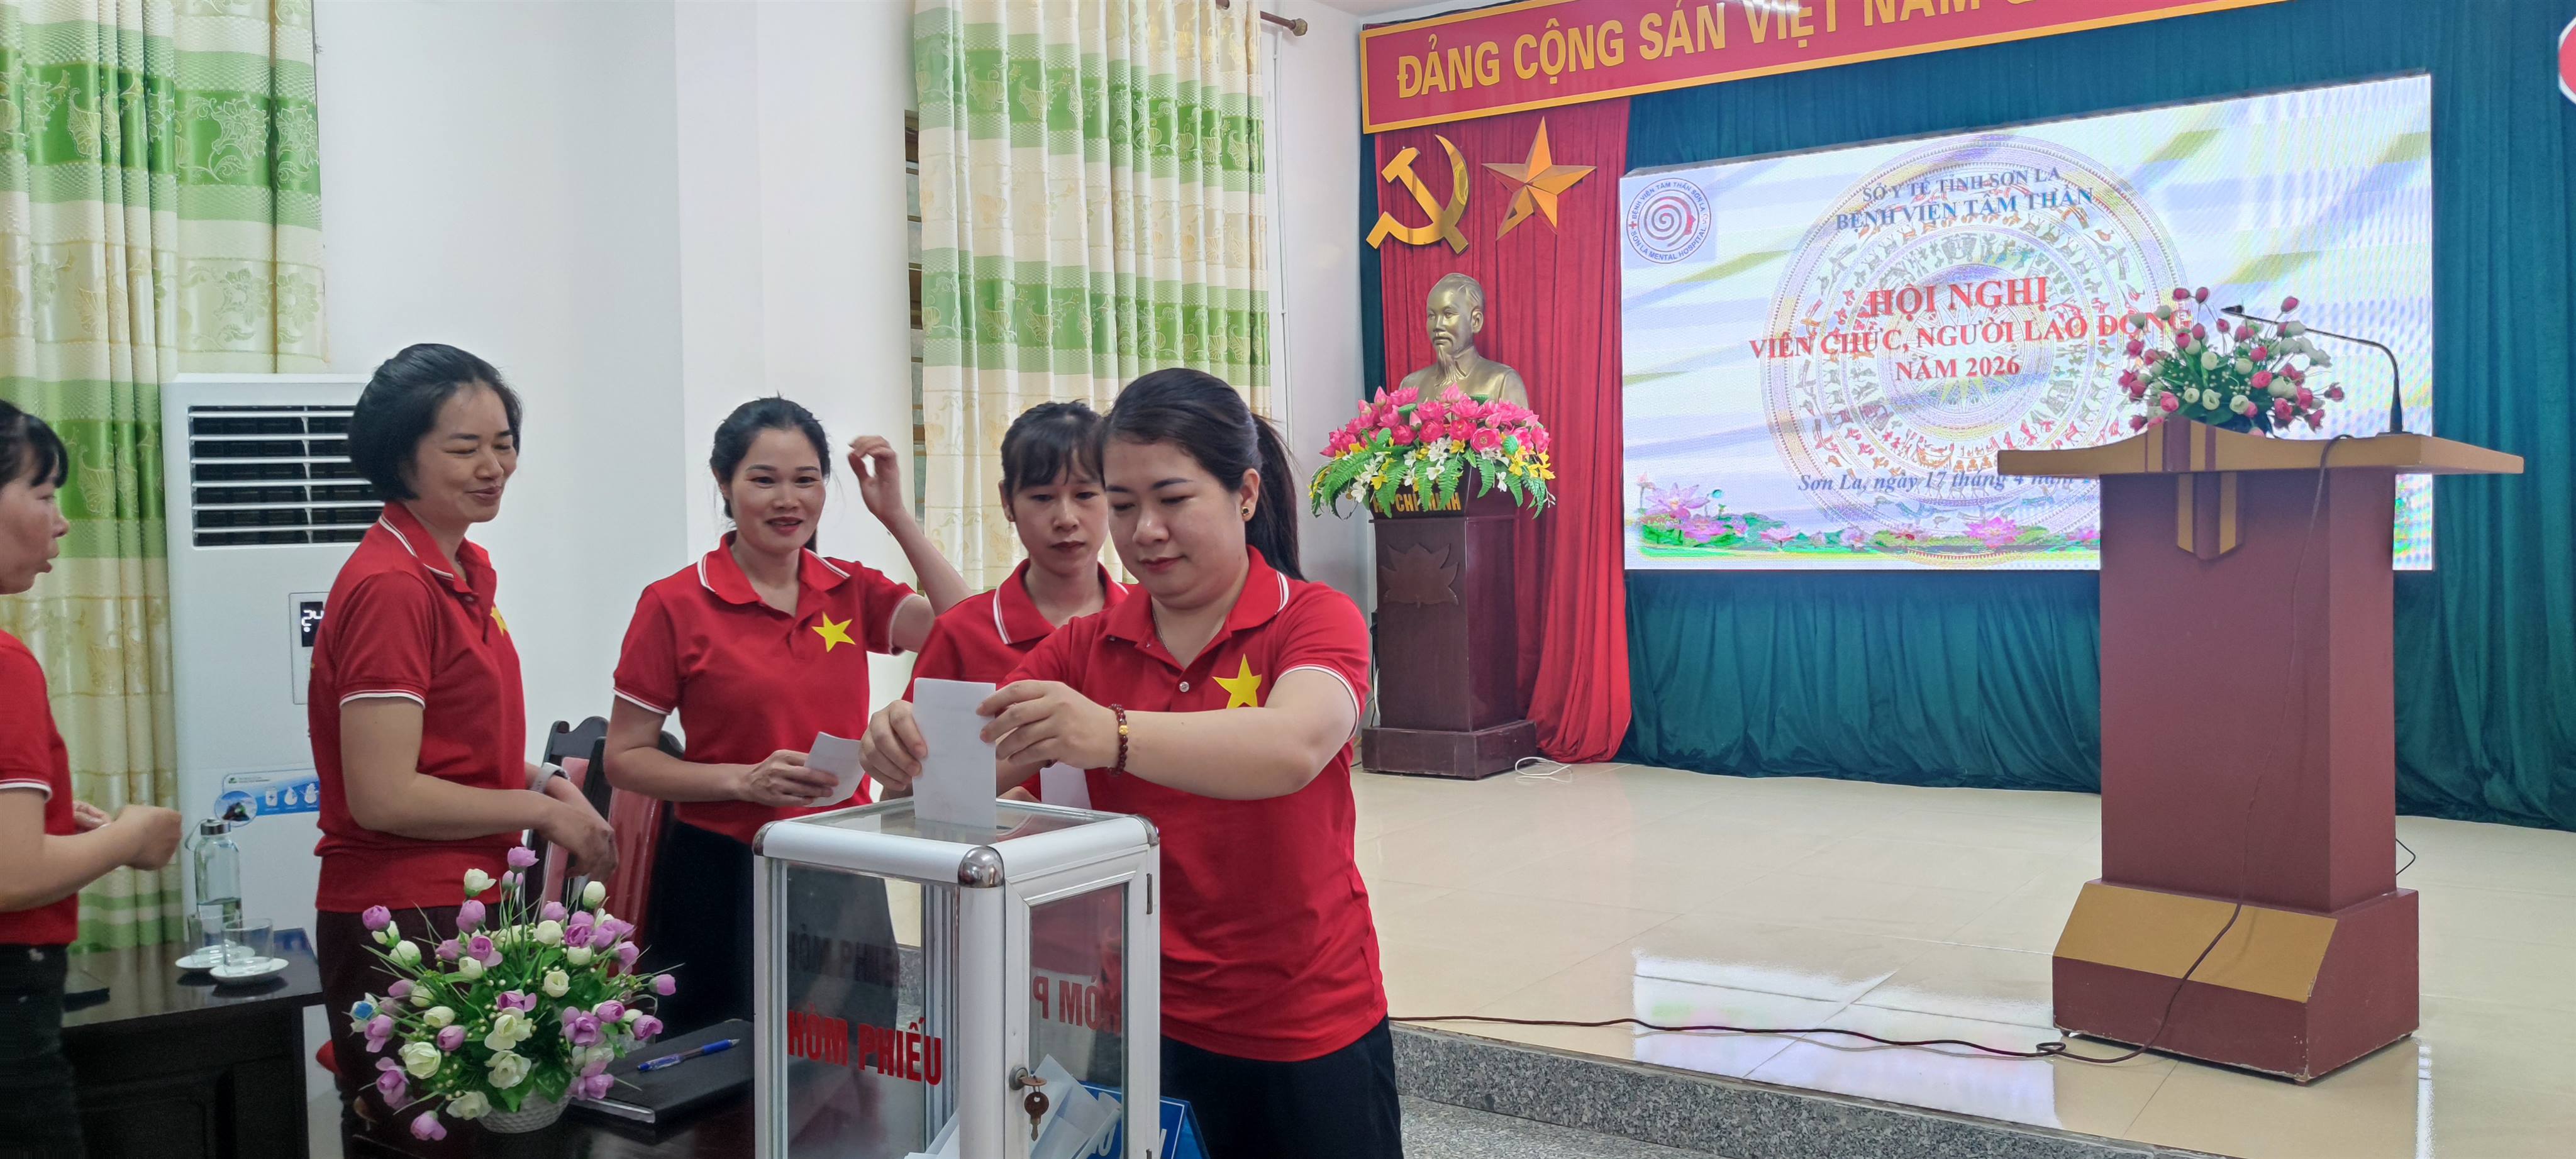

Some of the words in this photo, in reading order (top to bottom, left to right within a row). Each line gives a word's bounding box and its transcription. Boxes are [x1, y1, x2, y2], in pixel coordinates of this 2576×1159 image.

[1397, 33, 1501, 99] ĐẢNG
[1513, 18, 1624, 85] CỘNG
[1891, 184, 1902, 199] Y
[2035, 166, 2061, 183] LA
[1835, 210, 1896, 233] BỆNH
[1963, 193, 2018, 216] TÂM
[1648, 252, 1679, 261] MENTAL
[1678, 227, 1706, 258] HOSPITAL
[1868, 283, 1938, 322] HỘI
[1950, 276, 2049, 311] NGHỊ
[1749, 331, 1815, 359] VIÊN
[1917, 316, 2014, 348] NGƯỜI
[2024, 315, 2088, 343] LAO
[1896, 356, 1958, 380] NĂM
[1966, 355, 2021, 377] 2026
[1798, 474, 1833, 491] Sơn
[1840, 474, 1867, 491] La,
[1925, 471, 1948, 488] 17
[1952, 470, 2007, 491] tháng
[858, 1016, 942, 1086] PHIẾU
